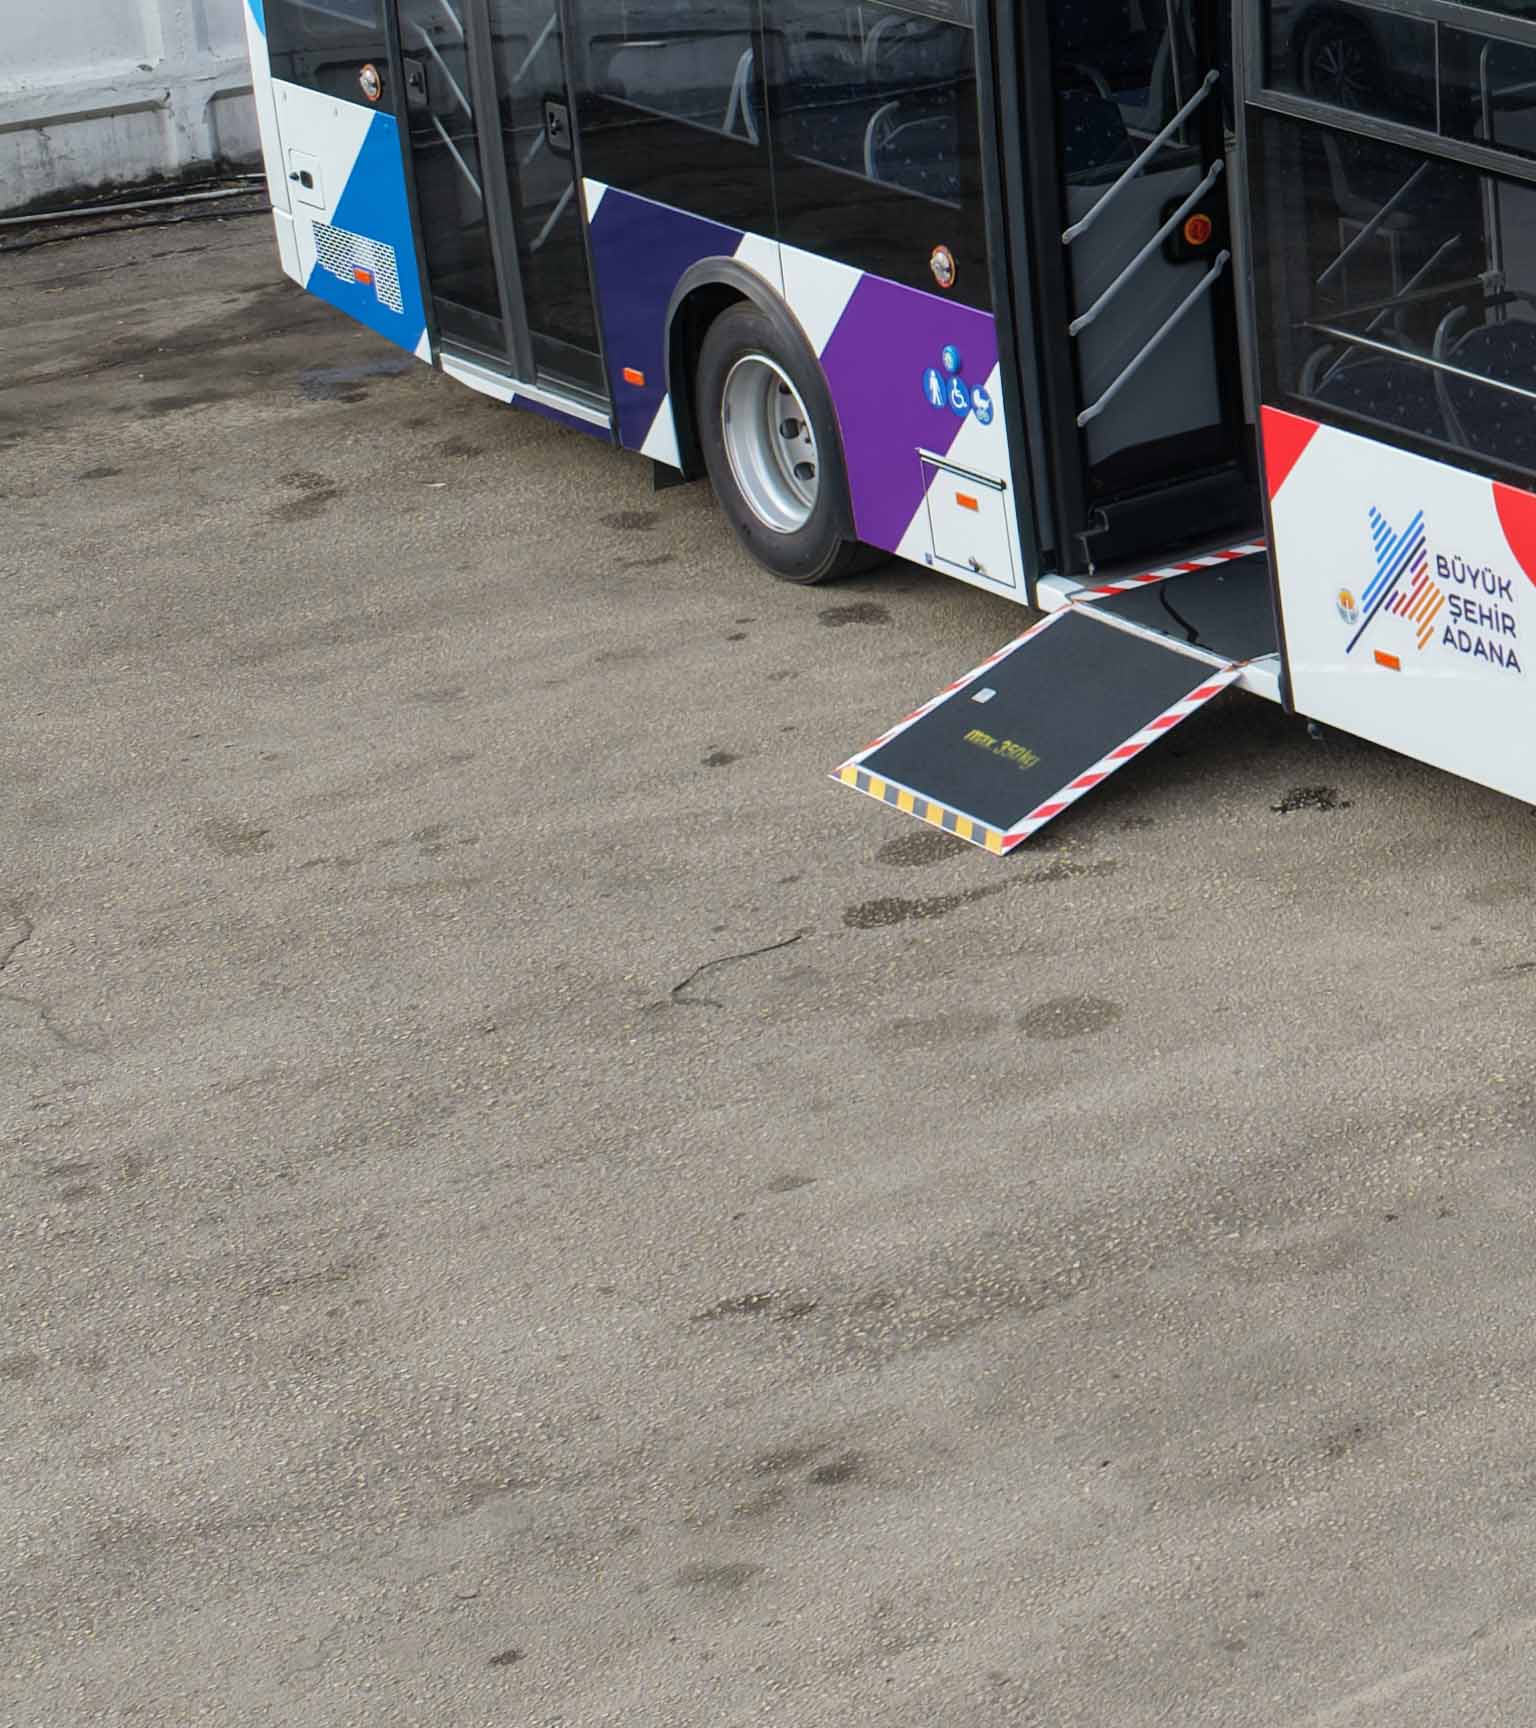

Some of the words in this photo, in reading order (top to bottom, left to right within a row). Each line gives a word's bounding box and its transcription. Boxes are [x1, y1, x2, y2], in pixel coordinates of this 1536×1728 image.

[1436, 554, 1514, 603] BÜYÜK
[1448, 593, 1517, 639] ŞEHİR
[1442, 625, 1521, 674] ADANA
